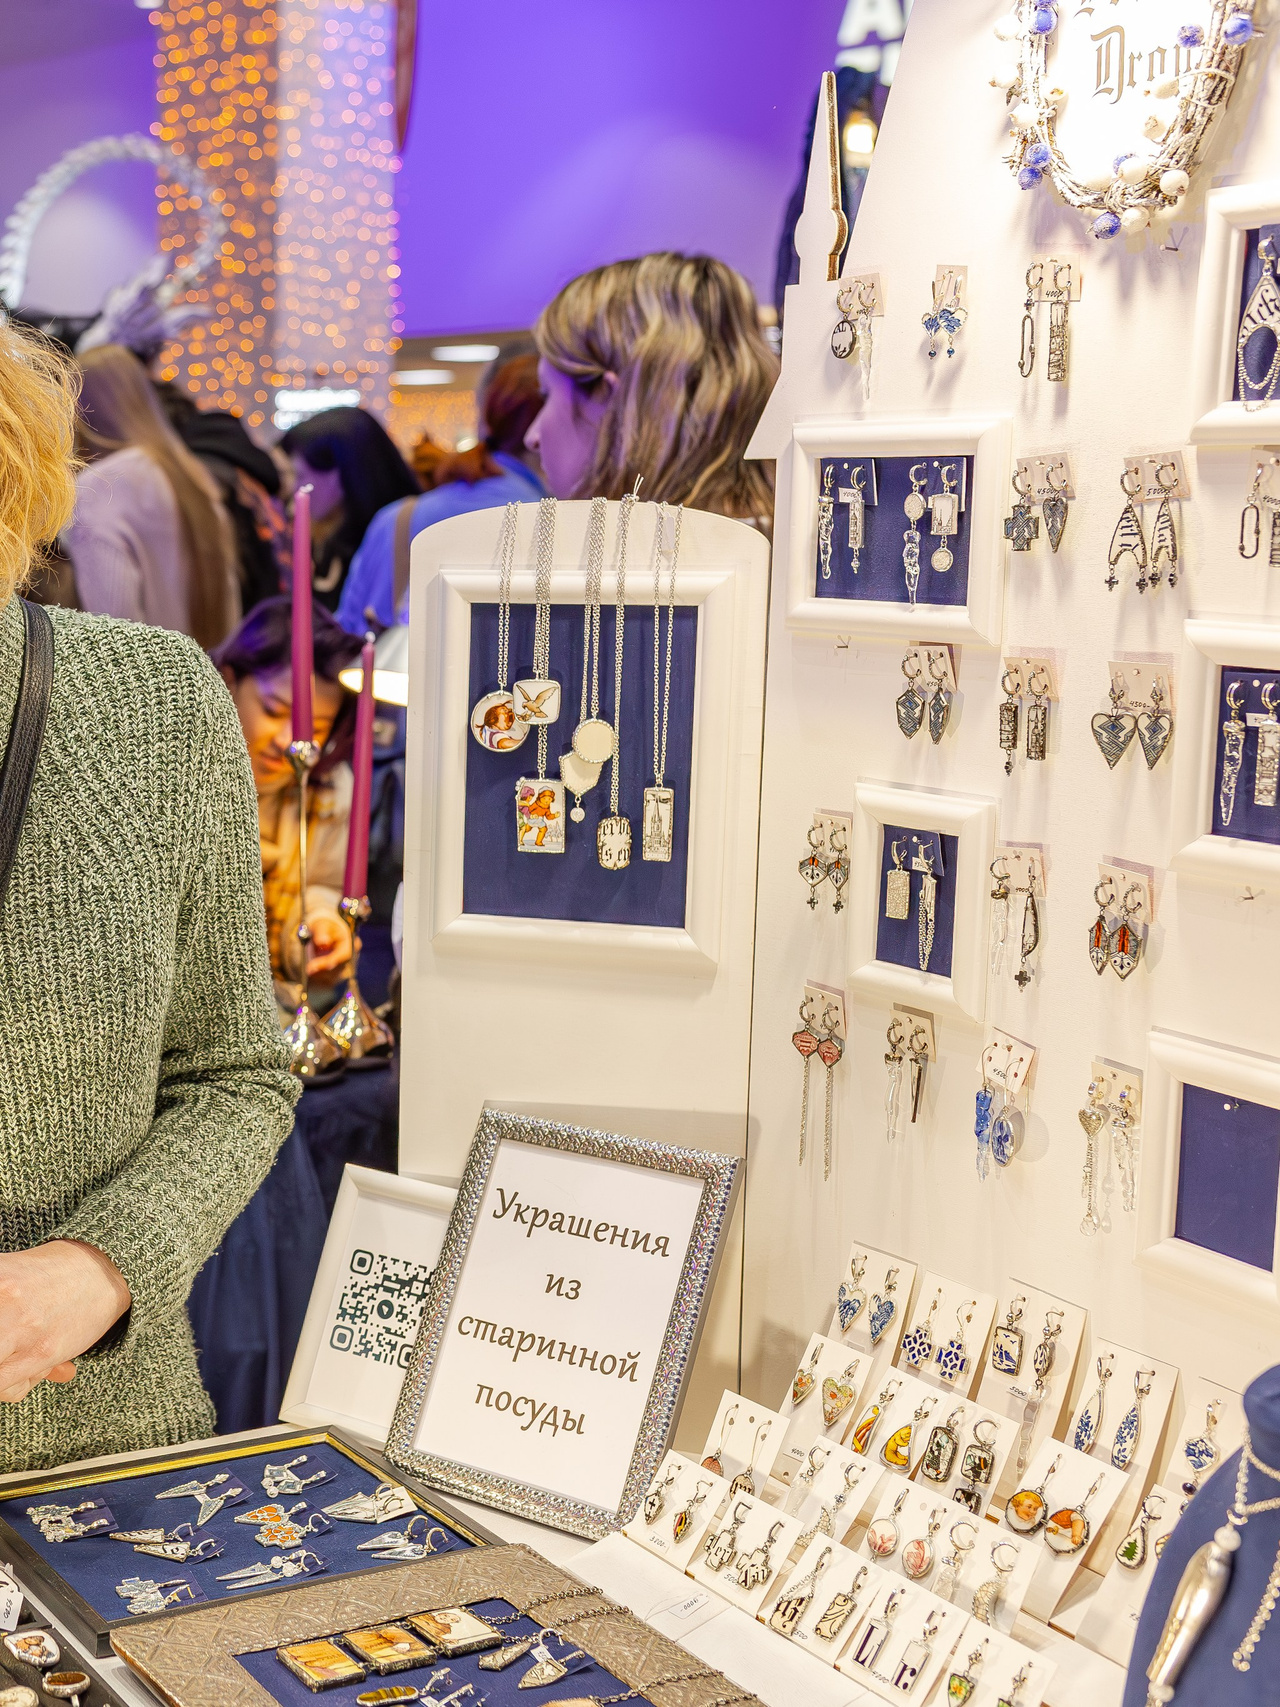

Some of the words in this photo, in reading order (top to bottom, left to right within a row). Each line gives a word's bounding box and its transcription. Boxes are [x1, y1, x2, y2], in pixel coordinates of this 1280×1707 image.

[492, 1188, 671, 1259] Украшения
[545, 1273, 582, 1300] из
[457, 1313, 639, 1383] старинной
[474, 1383, 585, 1437] посуды
